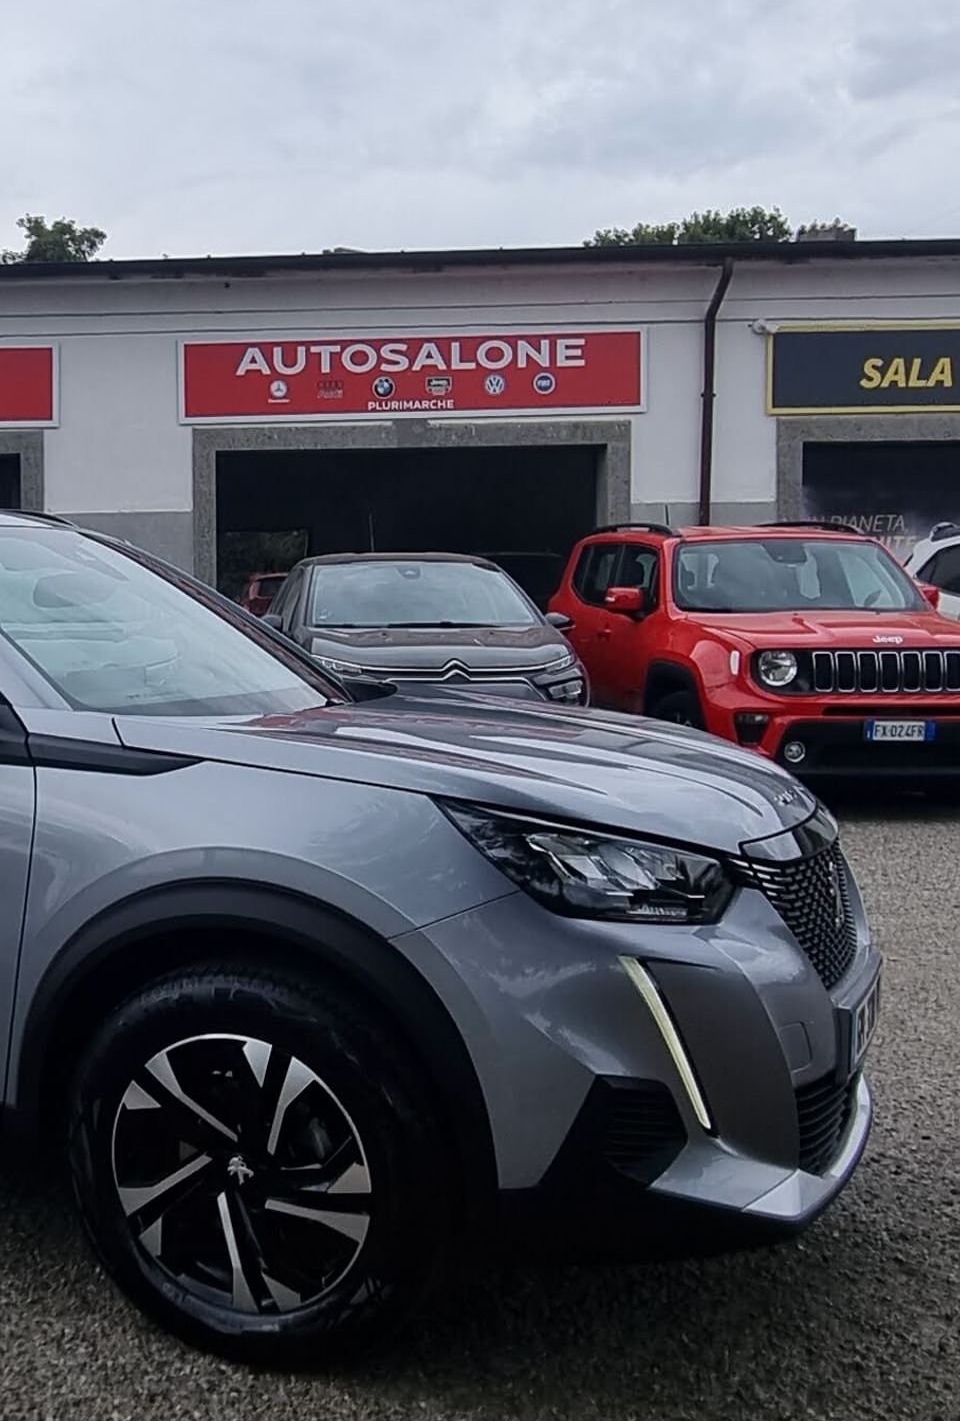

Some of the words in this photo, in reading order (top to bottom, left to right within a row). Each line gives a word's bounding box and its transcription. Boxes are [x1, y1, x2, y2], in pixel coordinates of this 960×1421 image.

[236, 338, 586, 376] AUTOSALONE
[860, 357, 953, 389] SALA
[368, 400, 454, 411] PLURIMARCHE
[872, 635, 903, 644] Jeep
